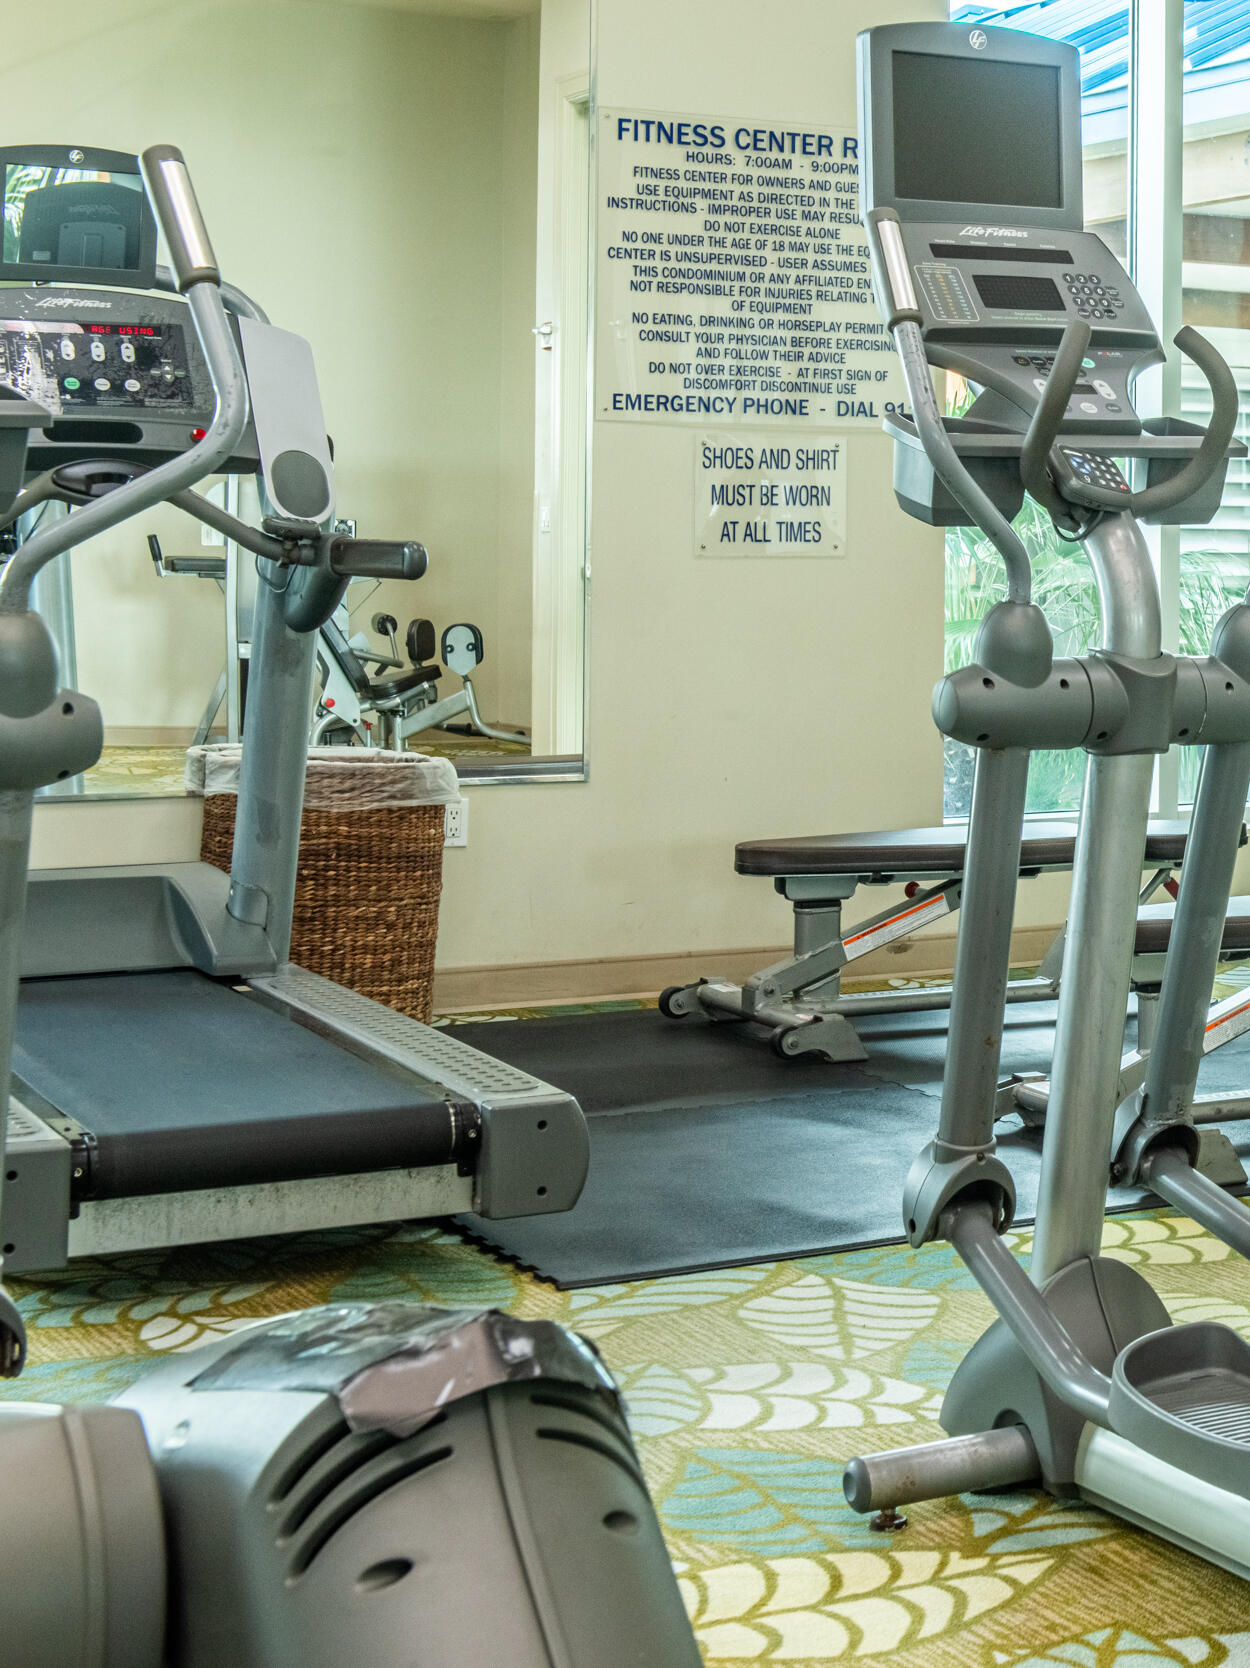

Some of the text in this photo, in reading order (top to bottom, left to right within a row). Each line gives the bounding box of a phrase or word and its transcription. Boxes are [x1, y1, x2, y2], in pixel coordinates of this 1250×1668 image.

[617, 117, 726, 149] FITNESS
[734, 127, 833, 157] CENTER
[686, 150, 736, 166] HOURS:
[744, 154, 792, 170] 7:00AM
[811, 160, 858, 176] 9:00PM
[633, 165, 681, 181] FITNESS
[683, 169, 728, 184] CENTER
[731, 172, 754, 186] FOR
[756, 175, 806, 190] OWNERS
[808, 179, 832, 192] AND
[636, 183, 856, 210] USE EQUIPMENT AS DIRECTED IN THE
[607, 196, 697, 214] INSTRUCTIONS
[708, 203, 772, 219] IMPROPER
[775, 207, 798, 221] USE
[801, 209, 826, 222] MAY
[829, 211, 861, 225] RESU
[703, 219, 841, 240] DO NOT EXERCISE ALONE
[622, 230, 638, 243] NO
[641, 232, 664, 245] ONE
[667, 233, 705, 247] UNDER
[707, 235, 728, 249] THE
[730, 237, 752, 250] AGE
[754, 238, 769, 251] OF
[771, 240, 786, 252] 18
[788, 240, 811, 253] MAY
[813, 242, 833, 255] USE
[835, 244, 855, 256] THE
[607, 246, 656, 261] CENTER
[659, 249, 672, 262] IS
[675, 250, 768, 268] UNSUPERVISED
[777, 256, 809, 270] USER
[811, 258, 867, 274] ASSUMES
[632, 264, 659, 278] THIS
[661, 266, 746, 283] CONDOMINIUM
[749, 271, 766, 284] OR
[768, 272, 791, 285] ANY
[793, 274, 854, 288] AFFILIATED
[629, 279, 654, 293] NOT
[656, 281, 736, 297] RESPONSIBLE
[738, 285, 761, 298] FOR
[764, 286, 813, 301] INJURIES
[815, 289, 867, 304] RELATING
[731, 299, 813, 315] OF EQUIPMENT
[120, 327, 153, 335] USING
[632, 311, 884, 335] NO EATING, DRINKING OR HORSEPLAY PERMIT
[638, 329, 691, 343] CONSULT
[694, 331, 725, 345] YOUR
[728, 333, 787, 347] PHYSICIAN
[790, 336, 833, 349] BEFORE
[695, 346, 846, 364] AND FOLLOW THEIR ADVICE
[648, 361, 666, 374] DO
[669, 362, 692, 375] NOT
[695, 363, 725, 376] OVER
[728, 364, 782, 378] EXERCISE
[796, 367, 810, 379] AT
[812, 367, 843, 380] FIRST
[846, 369, 872, 381] SIGN
[874, 370, 888, 382] OF
[683, 377, 857, 395] DISCOMFORT DISCONTINUE USE
[612, 393, 737, 414] EMERGENCY
[743, 397, 809, 416] PHONE
[836, 400, 879, 418] DIAL
[884, 401, 911, 415] 91
[702, 447, 839, 470] SHOES AND SHIRT
[712, 484, 830, 506] MUST BE WORN
[720, 521, 821, 542] AT ALL TIMES
